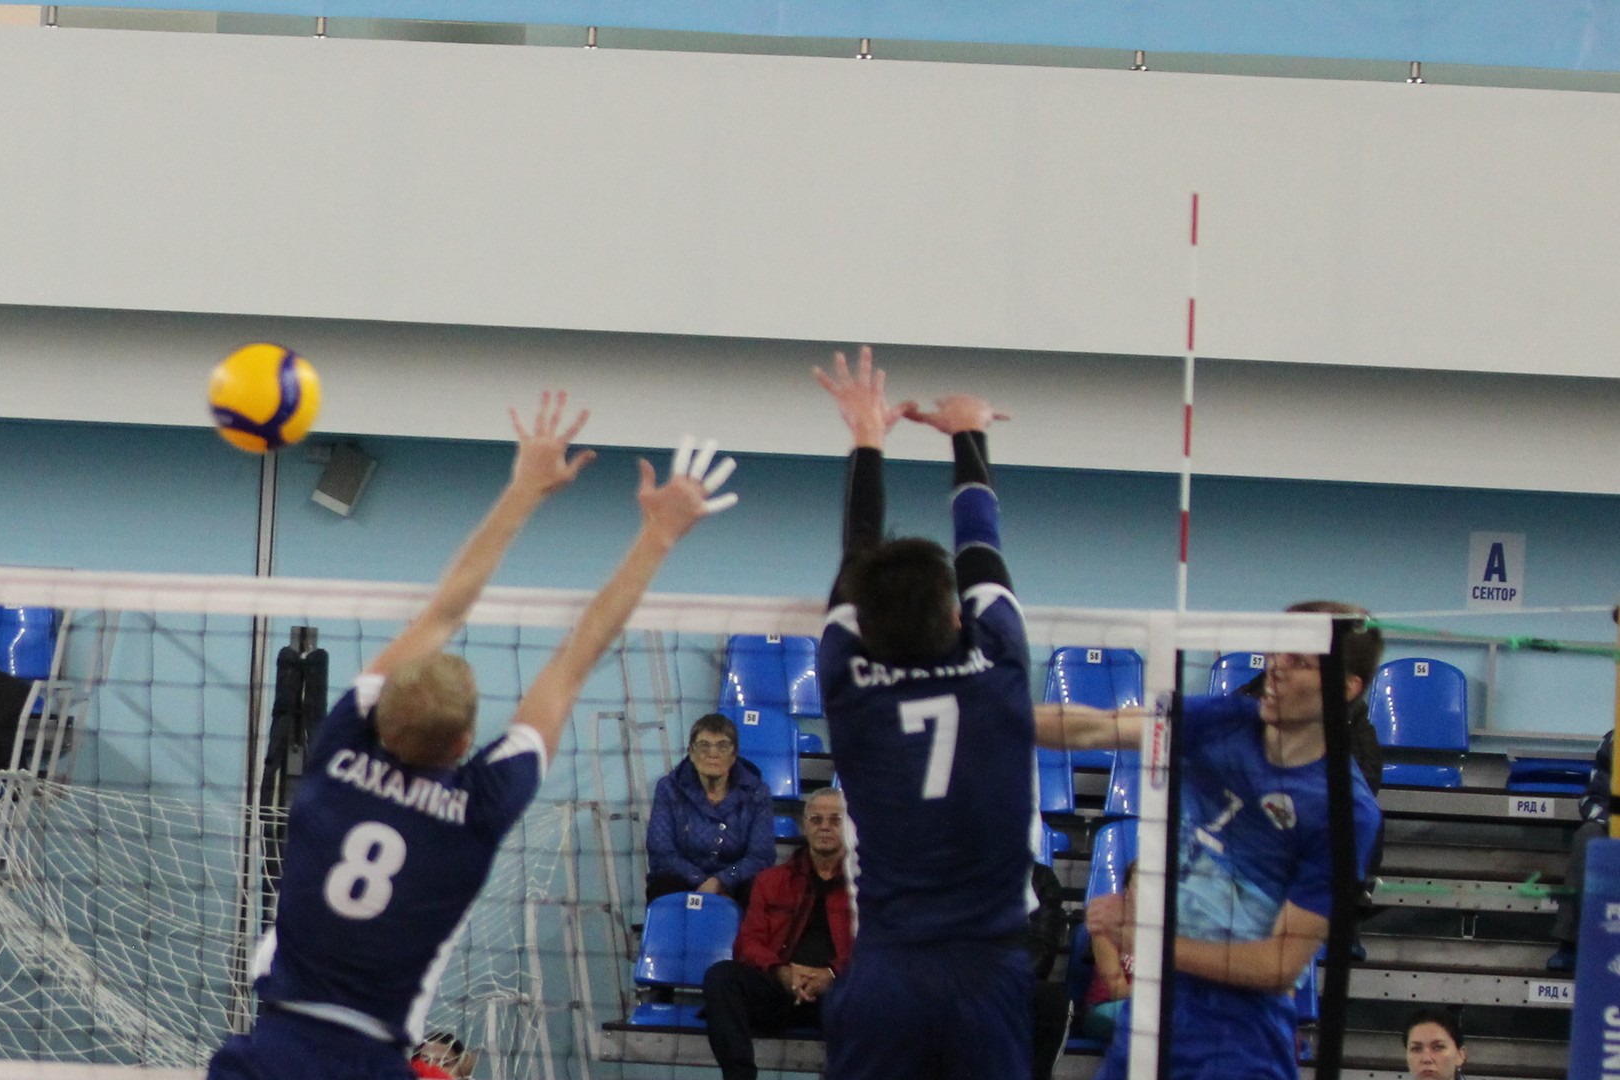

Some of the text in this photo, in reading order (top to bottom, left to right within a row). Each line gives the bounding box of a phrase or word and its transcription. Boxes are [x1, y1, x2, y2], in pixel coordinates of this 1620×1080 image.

[1483, 542, 1507, 583] А
[1472, 586, 1516, 601] СЕКТОР
[898, 693, 960, 800] 7
[327, 749, 469, 825] САХАЛИН
[1517, 801, 1546, 813] РЯД 6
[323, 820, 407, 920] 8
[1538, 986, 1568, 998] РЯД 4
